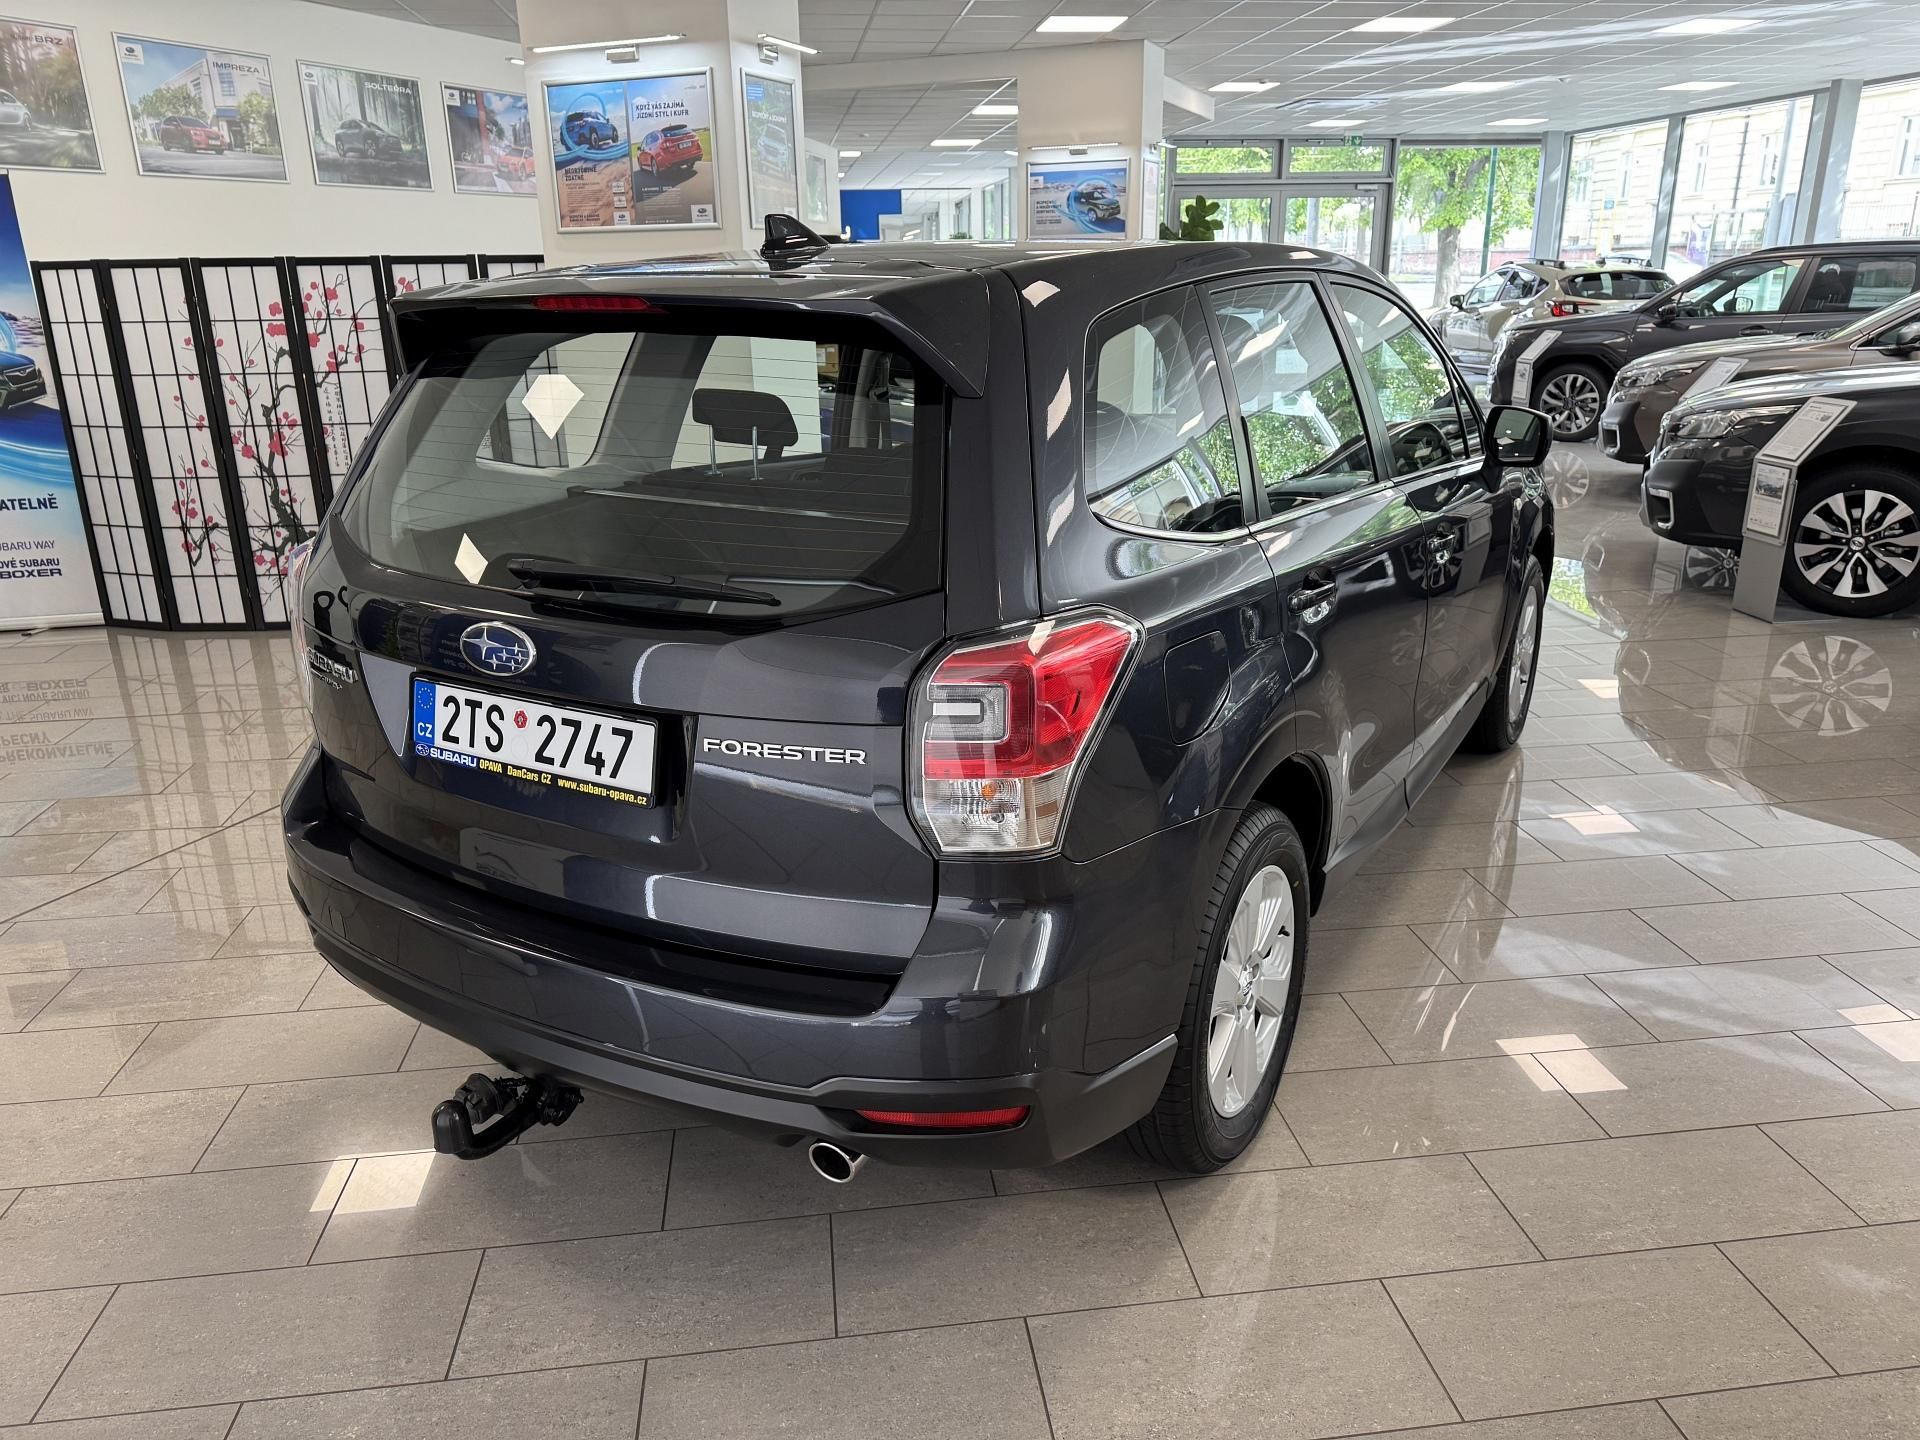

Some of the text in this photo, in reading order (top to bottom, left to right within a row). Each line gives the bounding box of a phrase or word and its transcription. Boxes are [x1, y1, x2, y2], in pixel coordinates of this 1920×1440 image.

[34, 35, 63, 46] BRZ
[212, 61, 260, 74] IMPREZA
[363, 81, 412, 95] SOLTERRA
[655, 110, 669, 118] STYL
[0, 540, 55, 551] BARU WAY
[19, 558, 60, 568] SUBARU
[0, 568, 63, 579] BOXER
[417, 722, 433, 738] CZ
[441, 695, 634, 780] 2TS 2747
[702, 737, 867, 765] FORESTER
[429, 747, 477, 768] SUBARU
[479, 758, 503, 774] OPAVA
[507, 765, 539, 782] DanCars
[541, 772, 552, 784] CZ
[557, 778, 648, 805] www.subaru-opava.cz
